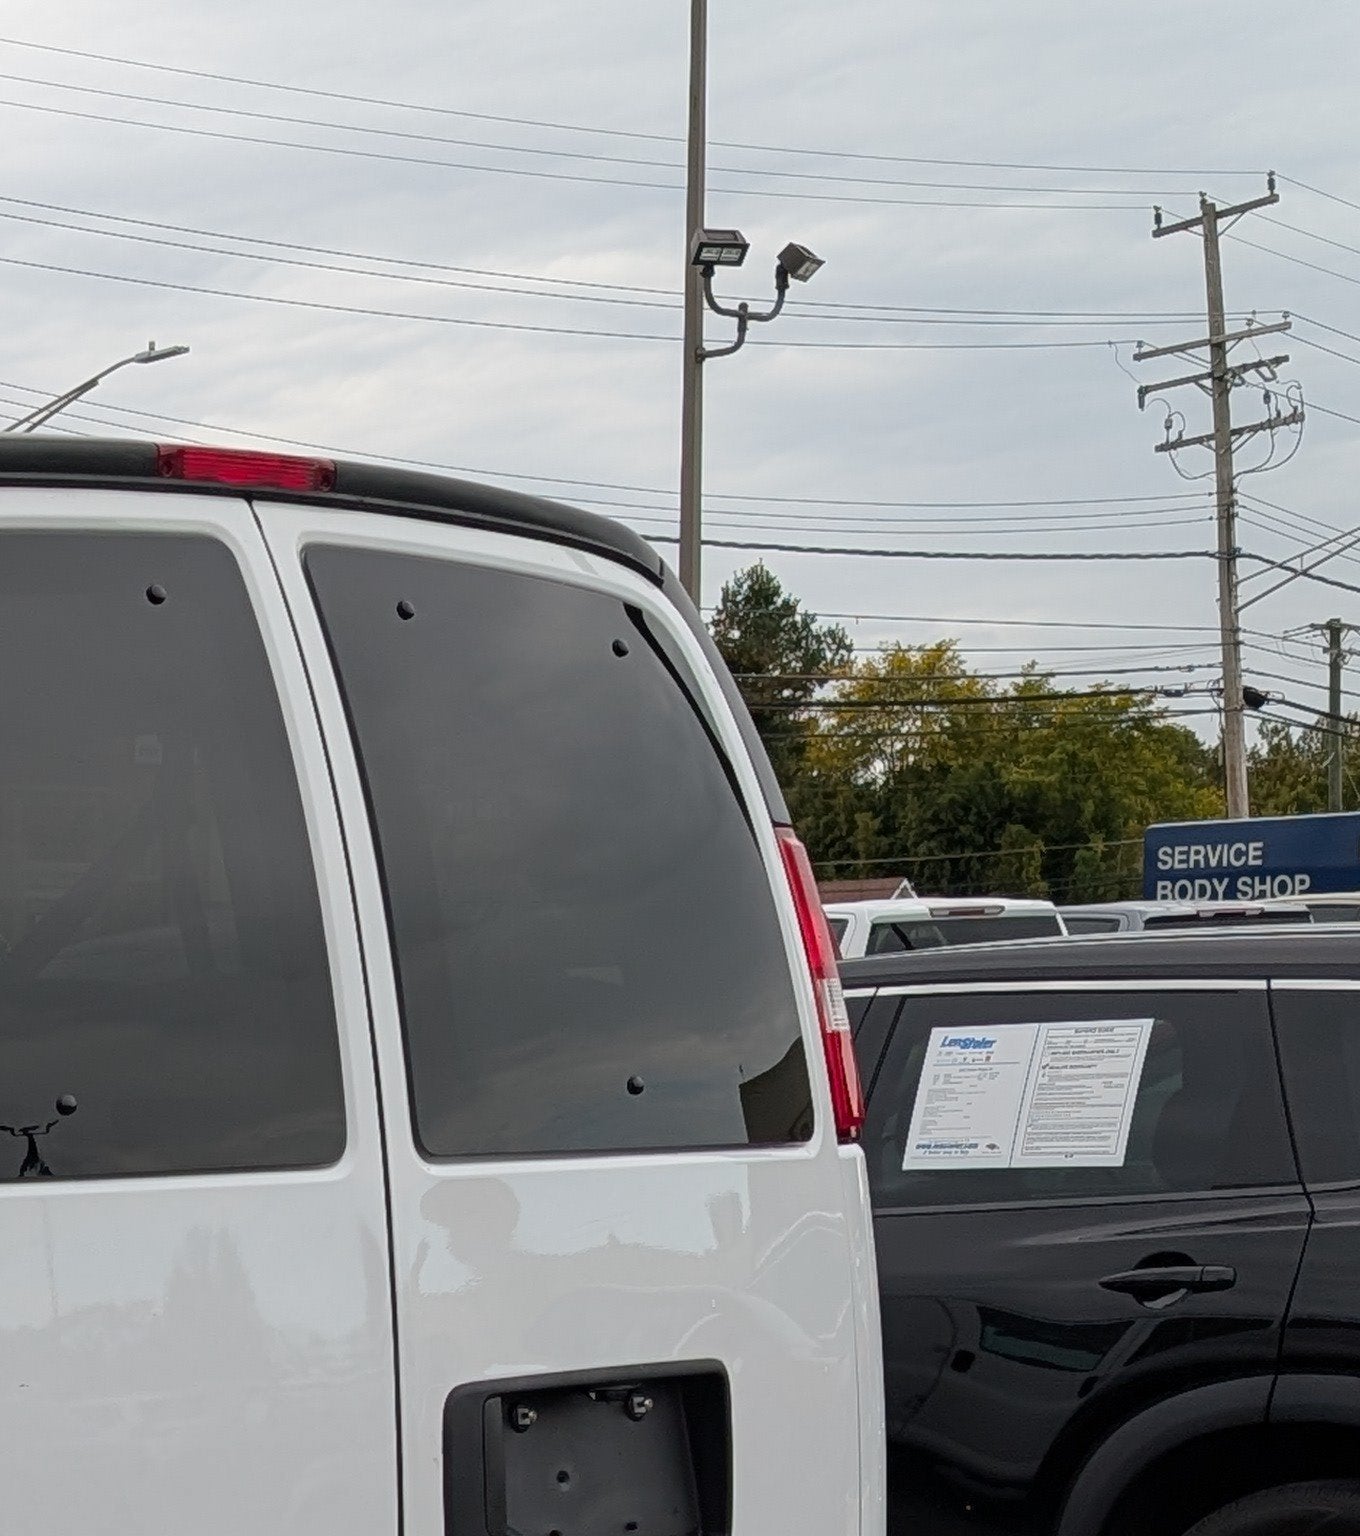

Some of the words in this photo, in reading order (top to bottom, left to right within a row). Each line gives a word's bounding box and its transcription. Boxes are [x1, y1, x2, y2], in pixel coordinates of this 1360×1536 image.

[1157, 842, 1264, 870] SERVICE
[1157, 878, 1230, 901] BODY
[1236, 874, 1311, 900] SHOP
